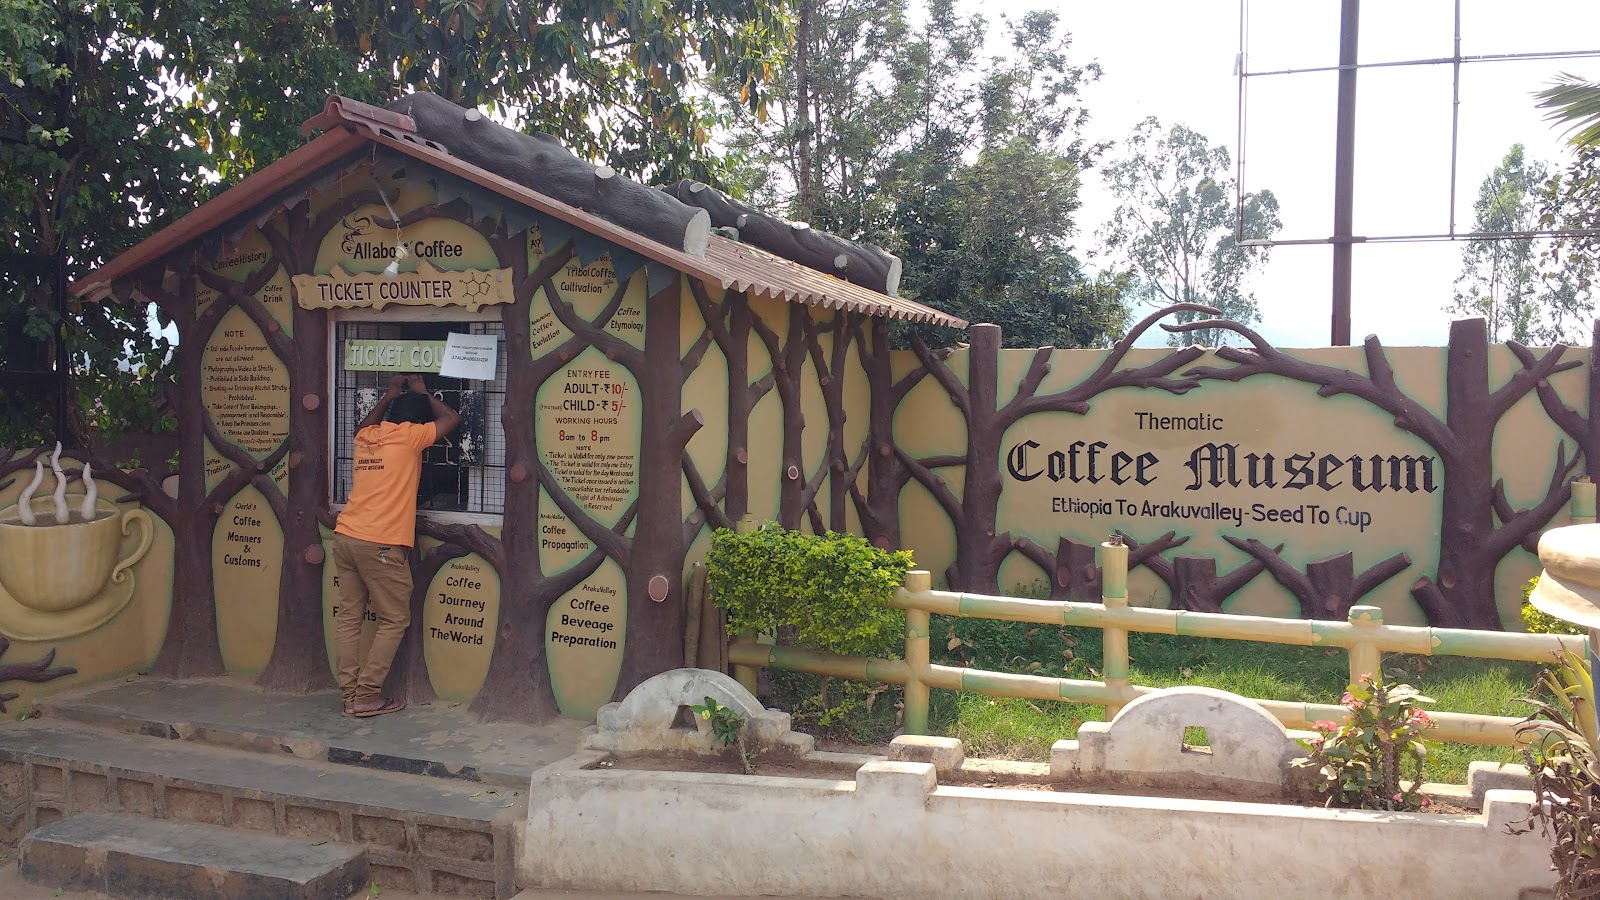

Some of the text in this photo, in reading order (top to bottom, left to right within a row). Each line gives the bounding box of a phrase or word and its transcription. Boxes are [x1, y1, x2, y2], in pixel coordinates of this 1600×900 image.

[353, 240, 463, 259] Allabo Coffee
[318, 280, 453, 302] TICKET COUNTER
[560, 281, 602, 294] Cultivation
[264, 294, 283, 302] Drink
[617, 308, 640, 316] Coffee
[532, 320, 553, 336] Coffee
[610, 320, 644, 332] Etymology
[532, 329, 560, 349] Evolution
[350, 346, 404, 367] TICKET
[568, 370, 592, 378] ENTRY
[564, 383, 599, 394] ADULT
[563, 400, 594, 411] CHILD
[1134, 412, 1224, 431] Thematic
[1007, 439, 1160, 486] Coffee
[1183, 442, 1438, 494] Museum
[1051, 497, 1112, 518] Ethiopia
[1116, 499, 1138, 516] To
[1306, 506, 1330, 524] To
[1335, 506, 1372, 530] Cup
[234, 516, 261, 526] Coffee
[542, 526, 566, 534] Coffee
[227, 531, 261, 544] Manners
[243, 545, 251, 553] &
[542, 539, 588, 552] Propagation
[224, 554, 261, 567] Customs
[446, 577, 481, 589] Coffee
[439, 594, 485, 612] Journey
[570, 599, 609, 612] Coffee
[445, 613, 484, 628] Around
[561, 614, 613, 633] Beveage
[551, 631, 617, 650] Preparation
